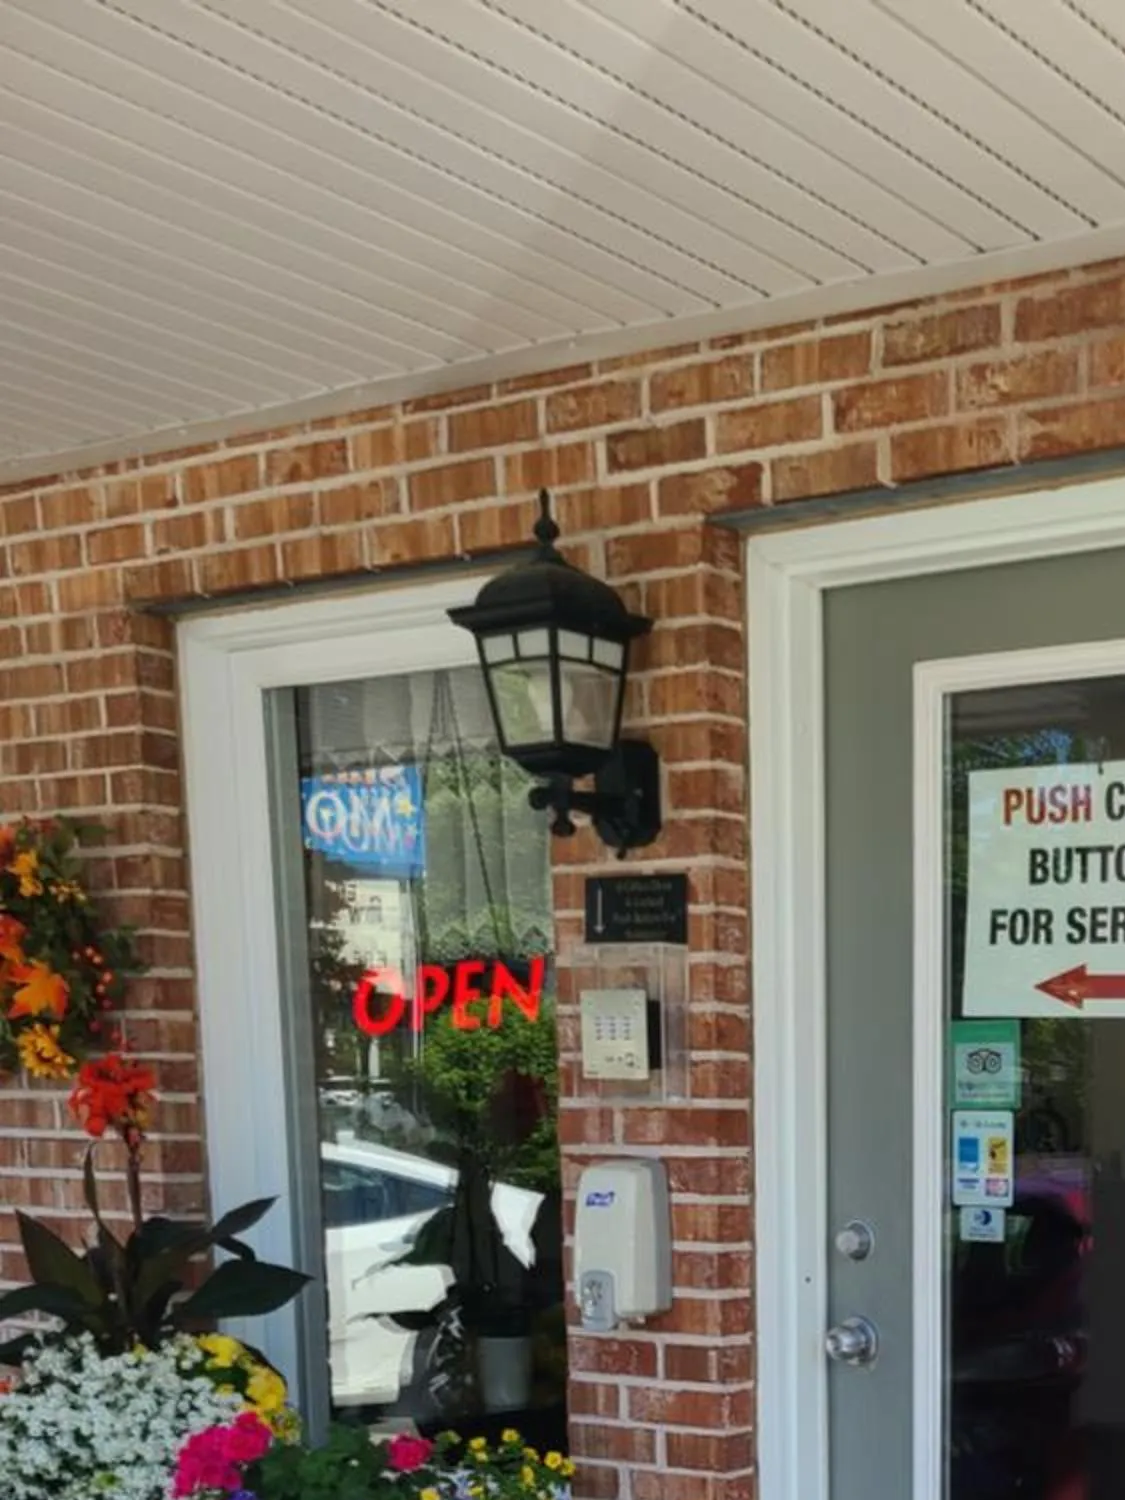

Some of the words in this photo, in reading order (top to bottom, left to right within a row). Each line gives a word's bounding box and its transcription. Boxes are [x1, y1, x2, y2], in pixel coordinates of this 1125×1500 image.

[1003, 785, 1092, 826] PUSH
[990, 908, 1053, 945] FOR
[353, 955, 545, 1036] OPEN
